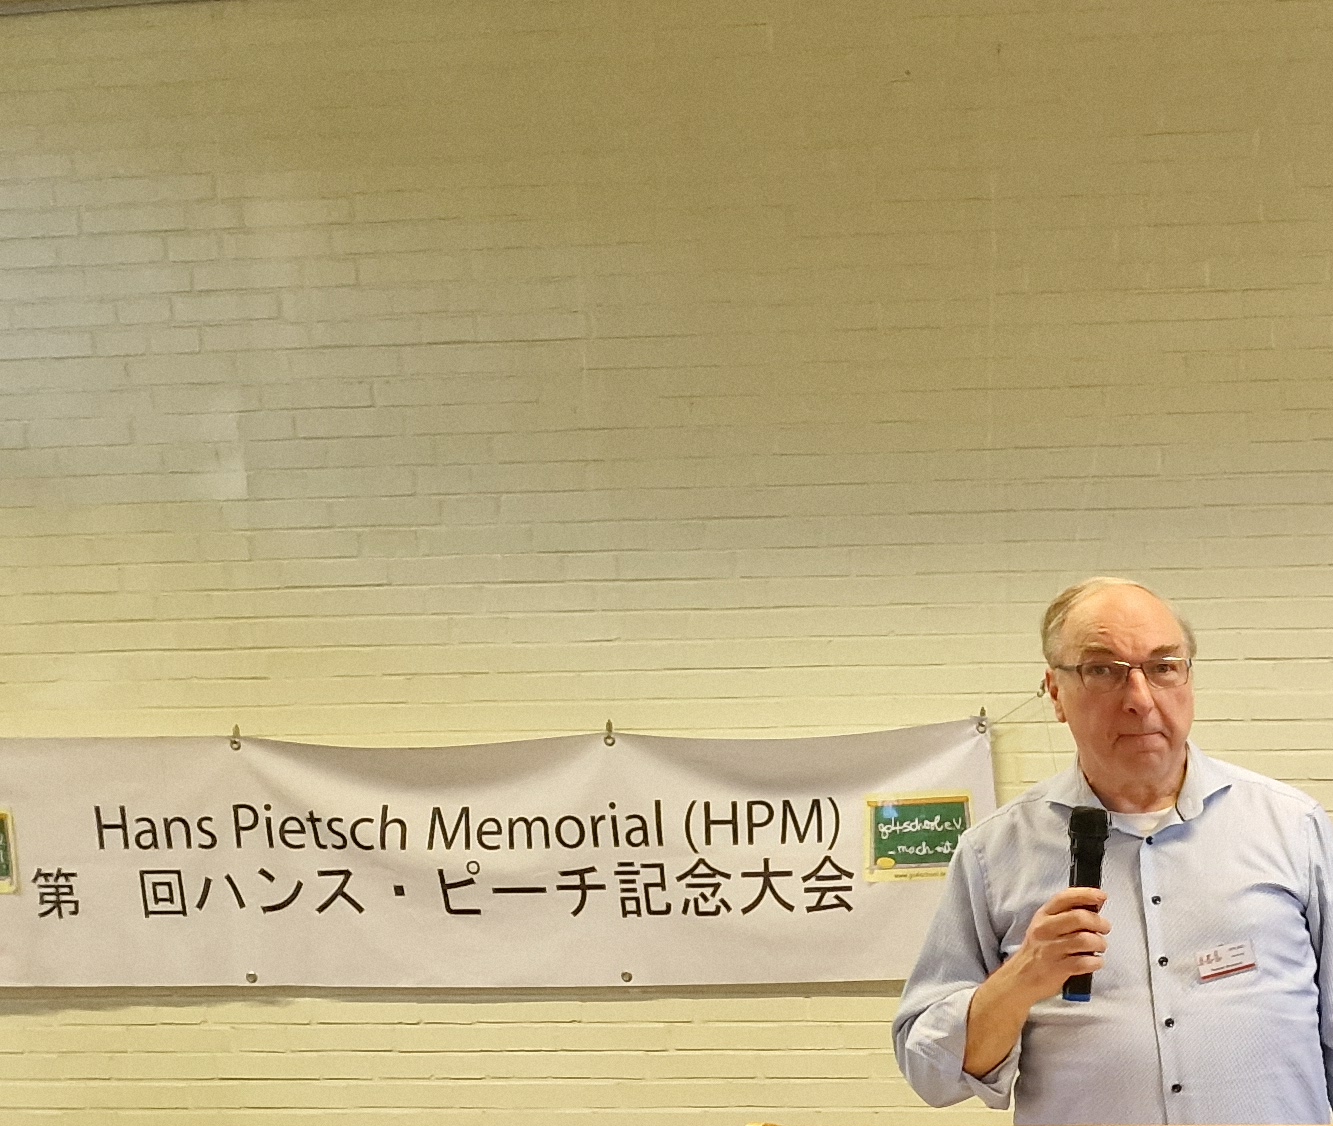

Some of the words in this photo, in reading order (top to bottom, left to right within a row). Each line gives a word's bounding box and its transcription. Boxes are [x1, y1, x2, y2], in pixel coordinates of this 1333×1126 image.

[93, 804, 217, 852] Hans
[235, 802, 408, 854] Pietsch
[427, 798, 665, 852] Memorial
[684, 796, 842, 857] (HPM)
[31, 867, 81, 920] 第
